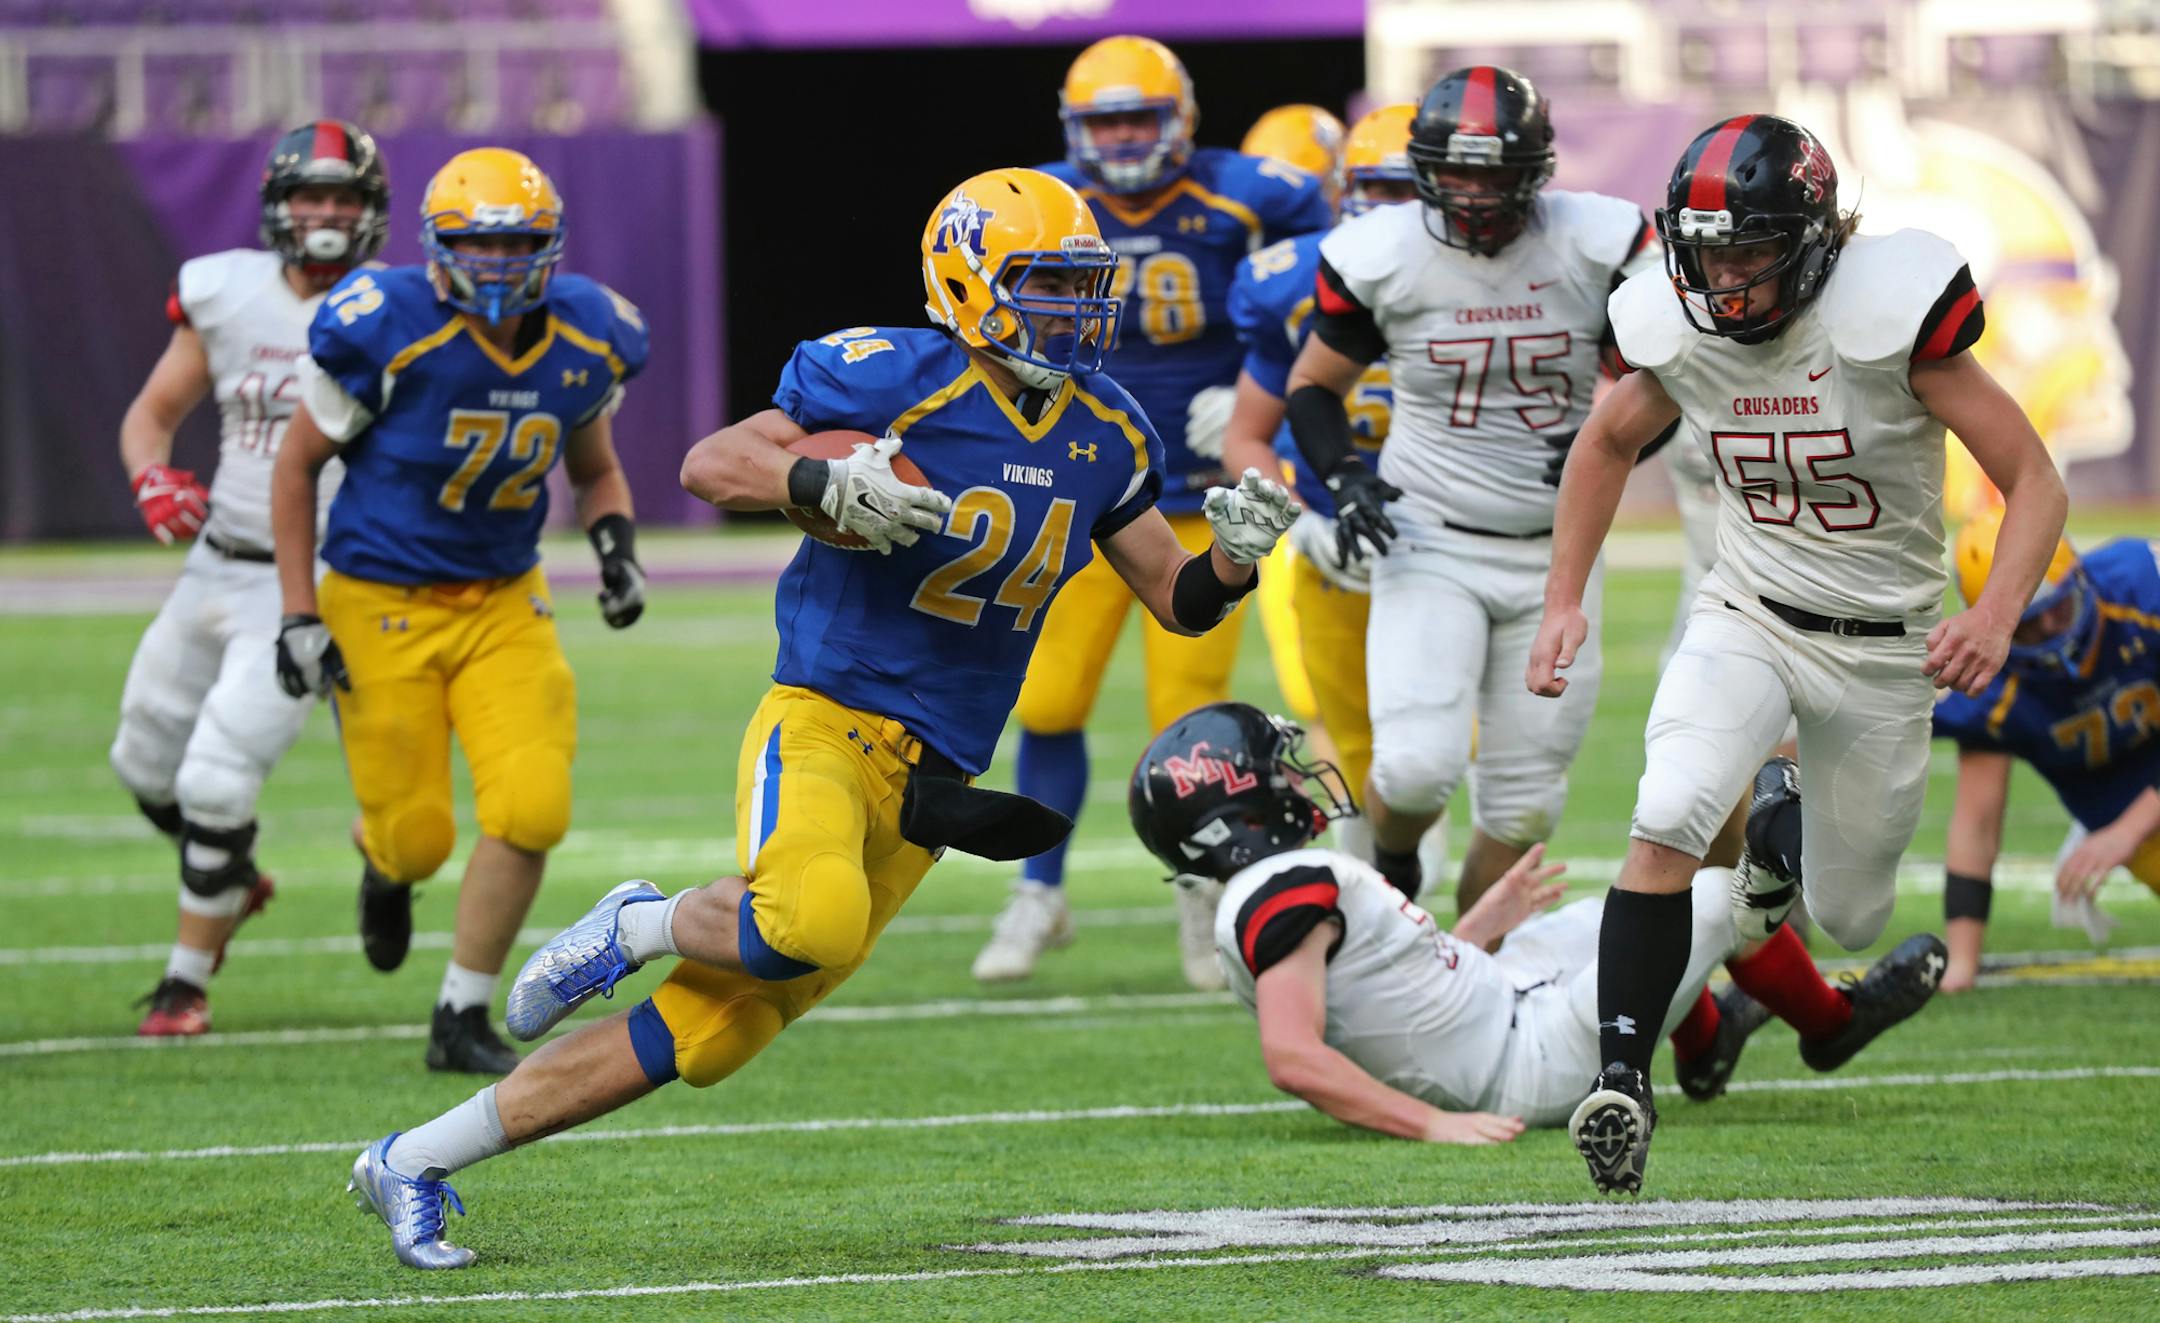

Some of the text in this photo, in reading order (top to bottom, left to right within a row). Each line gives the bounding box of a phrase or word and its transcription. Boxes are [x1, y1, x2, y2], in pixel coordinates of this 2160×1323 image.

[1455, 303, 1544, 325] CRUSADERS
[819, 326, 896, 365] 24
[1428, 330, 1573, 430] 75
[1733, 396, 1819, 416] CRUSADERS
[438, 408, 562, 513] 72
[1002, 463, 1053, 488] VIKINGS
[1710, 427, 1881, 533] 55
[909, 485, 1077, 632] 24
[1164, 741, 1258, 799] ML
